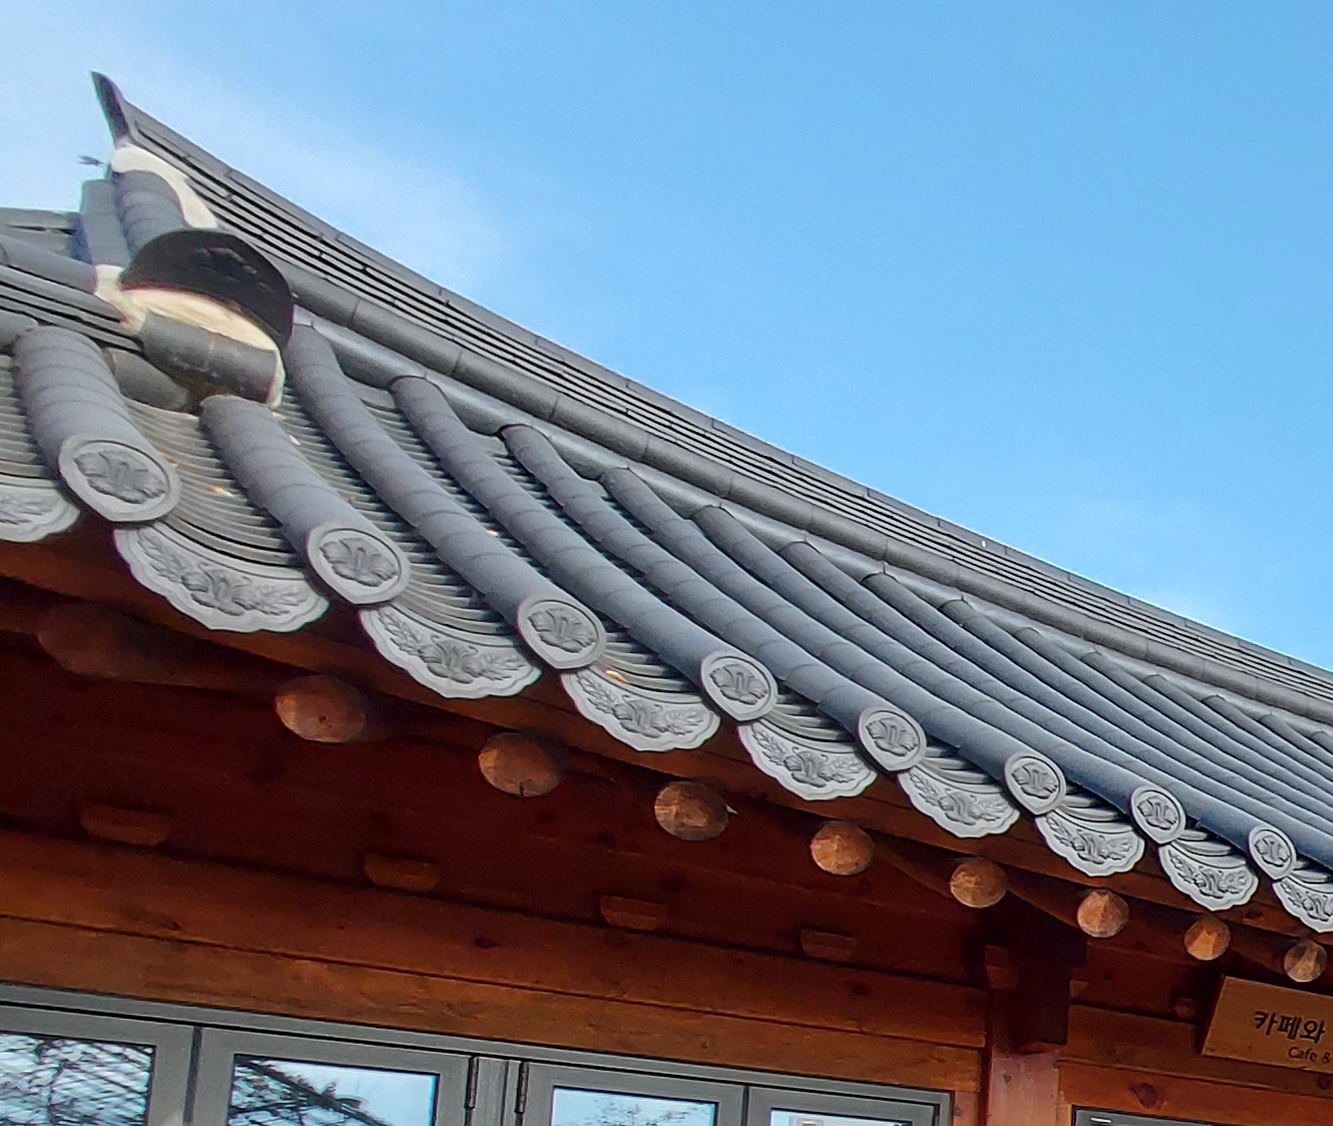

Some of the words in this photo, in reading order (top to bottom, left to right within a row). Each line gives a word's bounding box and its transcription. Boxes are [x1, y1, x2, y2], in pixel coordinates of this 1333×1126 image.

[1254, 1011, 1326, 1044] 카페와
[1288, 1046, 1318, 1063] Cafe
[1321, 1053, 1331, 1065] &
